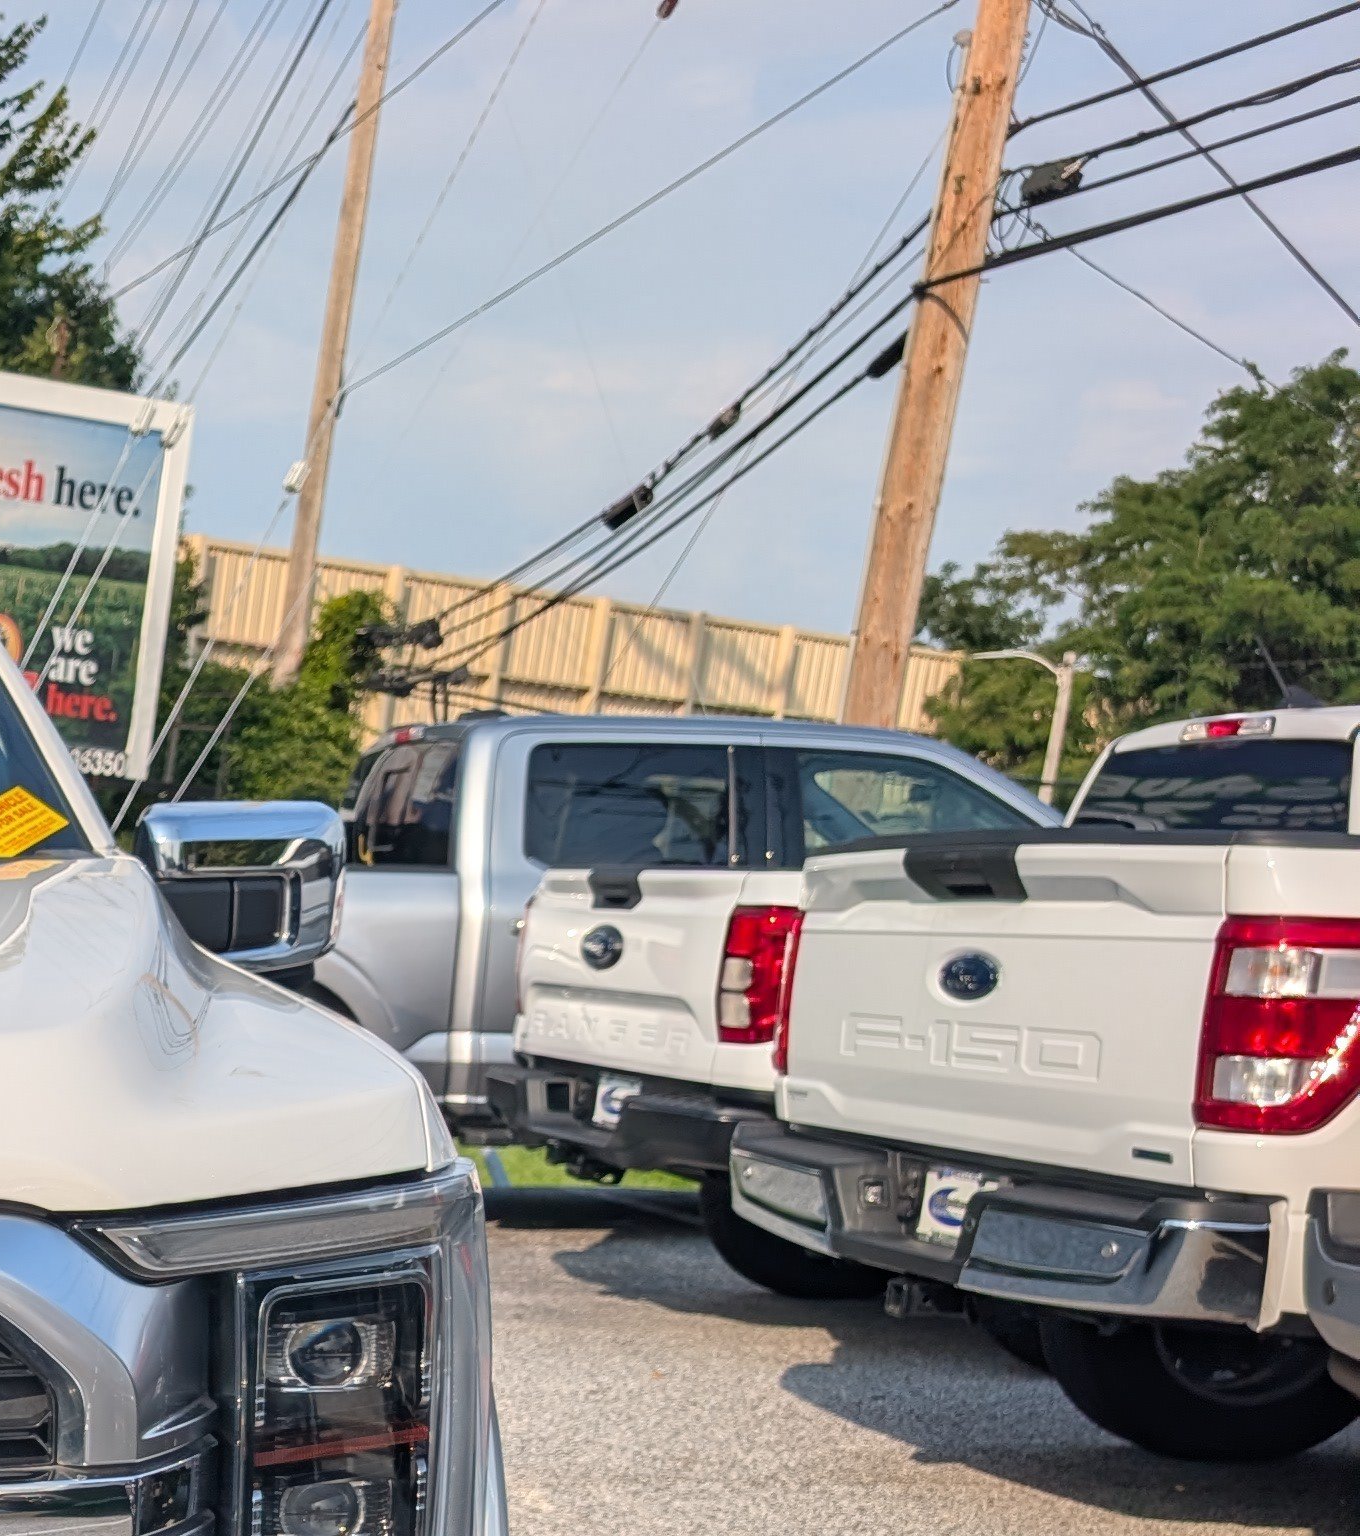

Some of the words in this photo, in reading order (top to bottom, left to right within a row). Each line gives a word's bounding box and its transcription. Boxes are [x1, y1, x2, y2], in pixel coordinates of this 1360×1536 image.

[52, 464, 141, 518] here.
[51, 625, 95, 656] we
[48, 655, 100, 687] are
[47, 683, 117, 722] here.
[839, 1011, 1102, 1084] F-150
